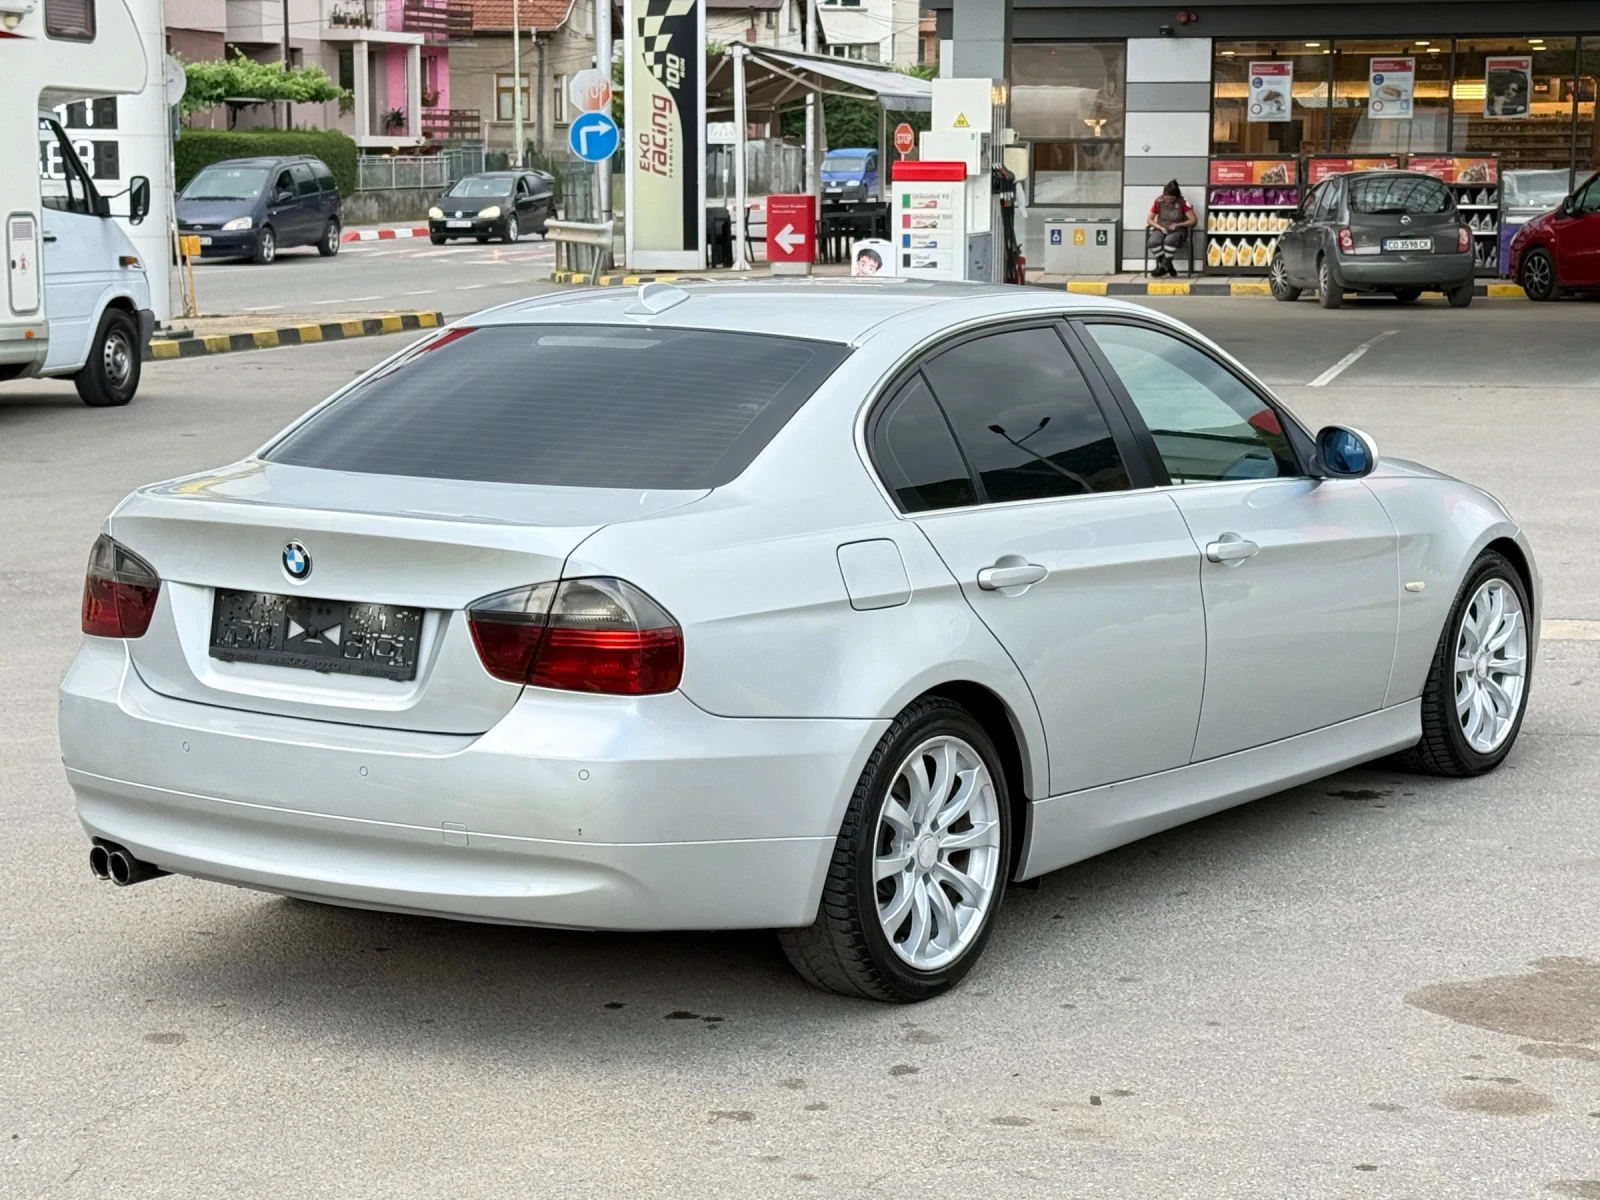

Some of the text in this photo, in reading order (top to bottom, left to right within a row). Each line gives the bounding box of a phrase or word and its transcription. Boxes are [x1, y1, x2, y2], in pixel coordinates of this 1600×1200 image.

[666, 53, 680, 89] 100
[639, 132, 651, 173] EKO
[652, 93, 673, 177] racing
[896, 133, 912, 145] STOP
